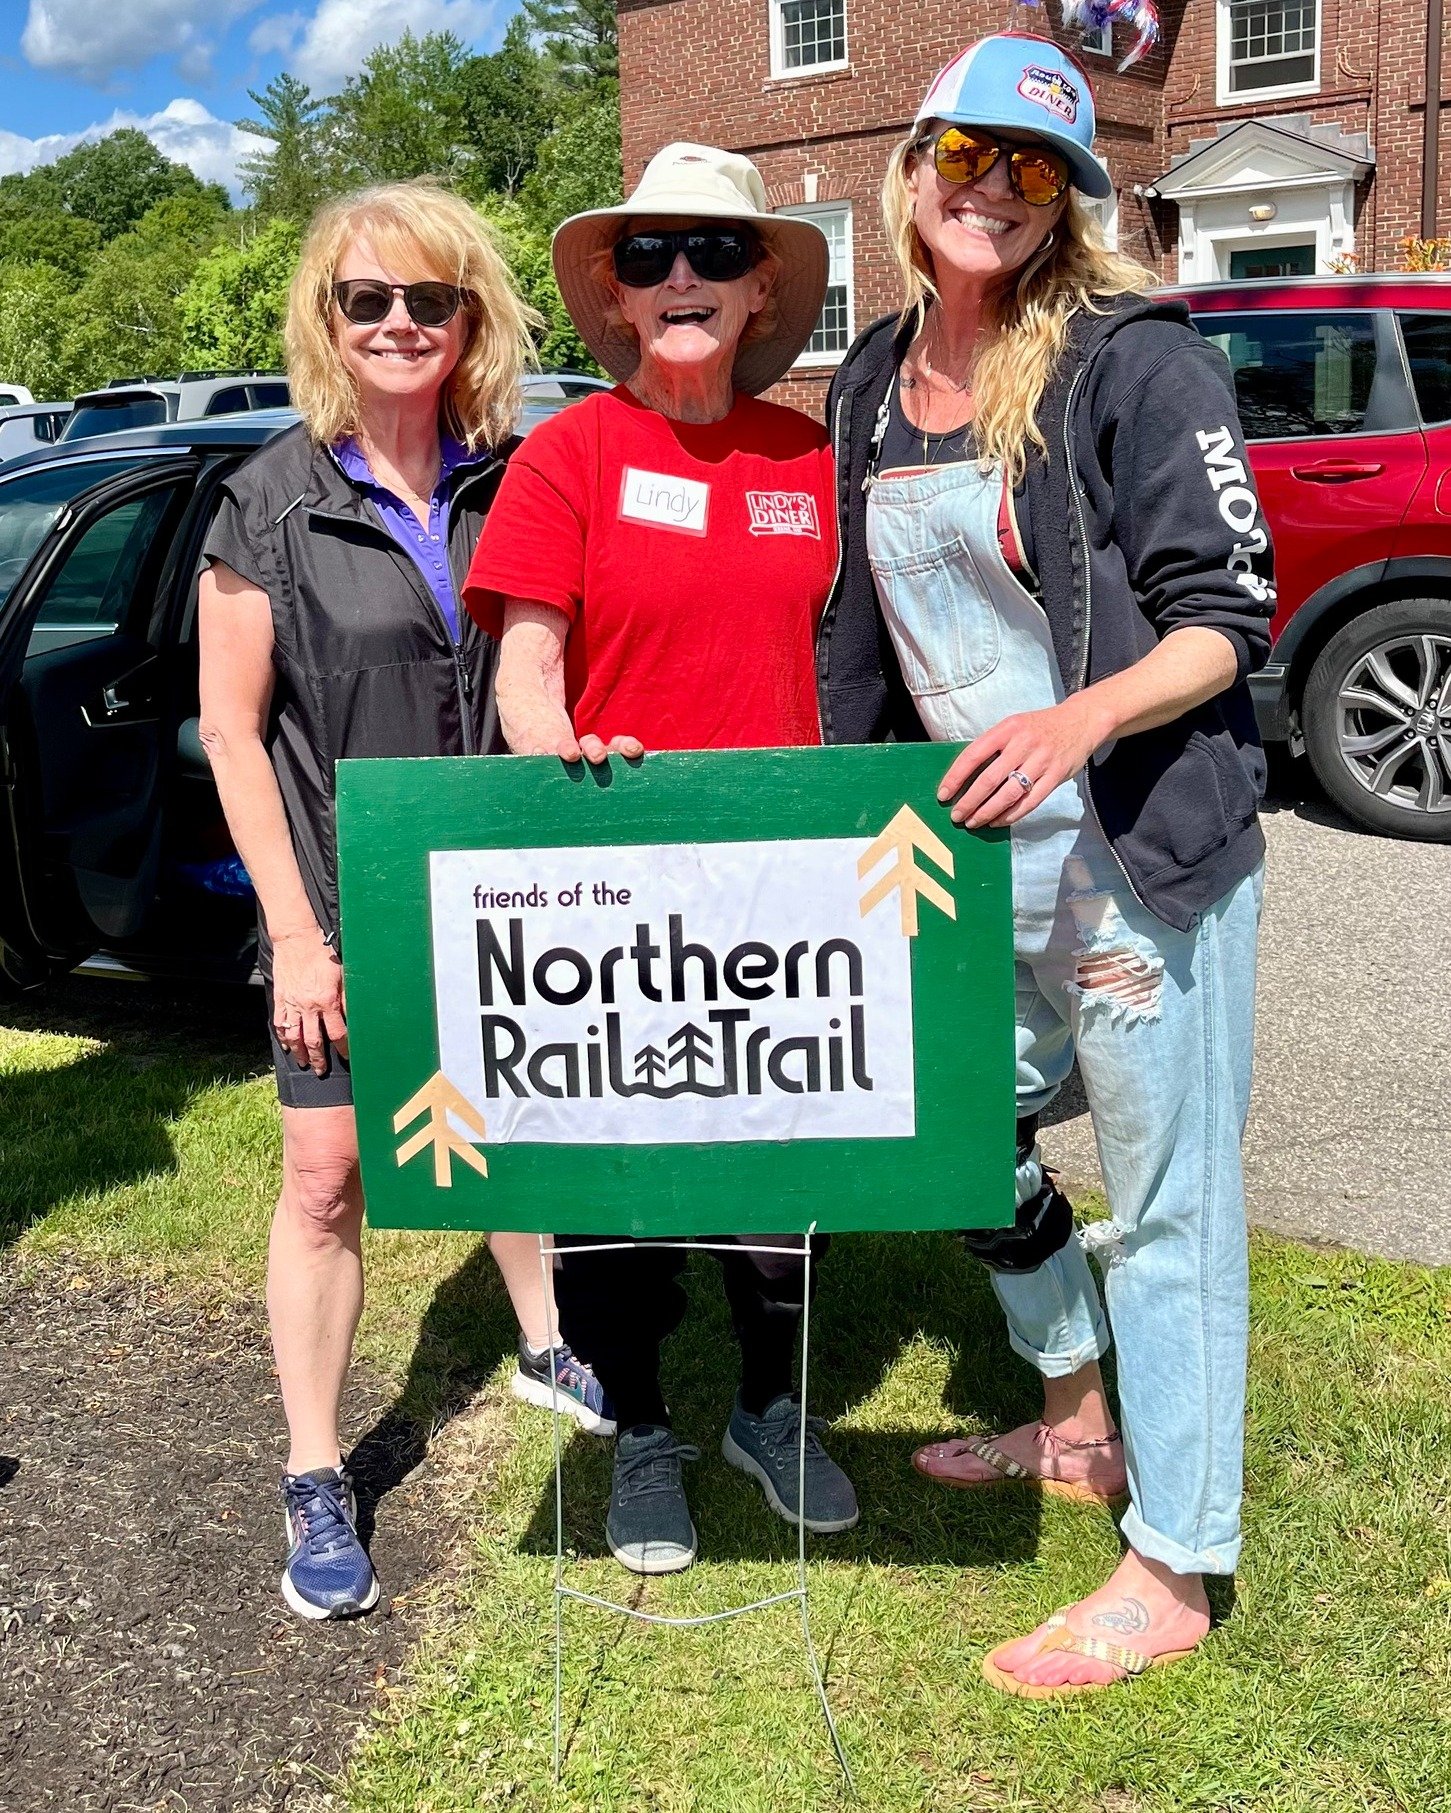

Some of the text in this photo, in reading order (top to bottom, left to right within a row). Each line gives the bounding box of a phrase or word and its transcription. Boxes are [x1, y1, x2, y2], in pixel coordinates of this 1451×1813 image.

[1028, 87, 1073, 118] DINER
[636, 483, 700, 522] Lindy
[750, 494, 808, 511] LINDY'S
[754, 509, 812, 525] DINER
[473, 880, 632, 909] friends of the
[476, 913, 863, 1007] Northern
[481, 1004, 873, 1099] Rail Trail
